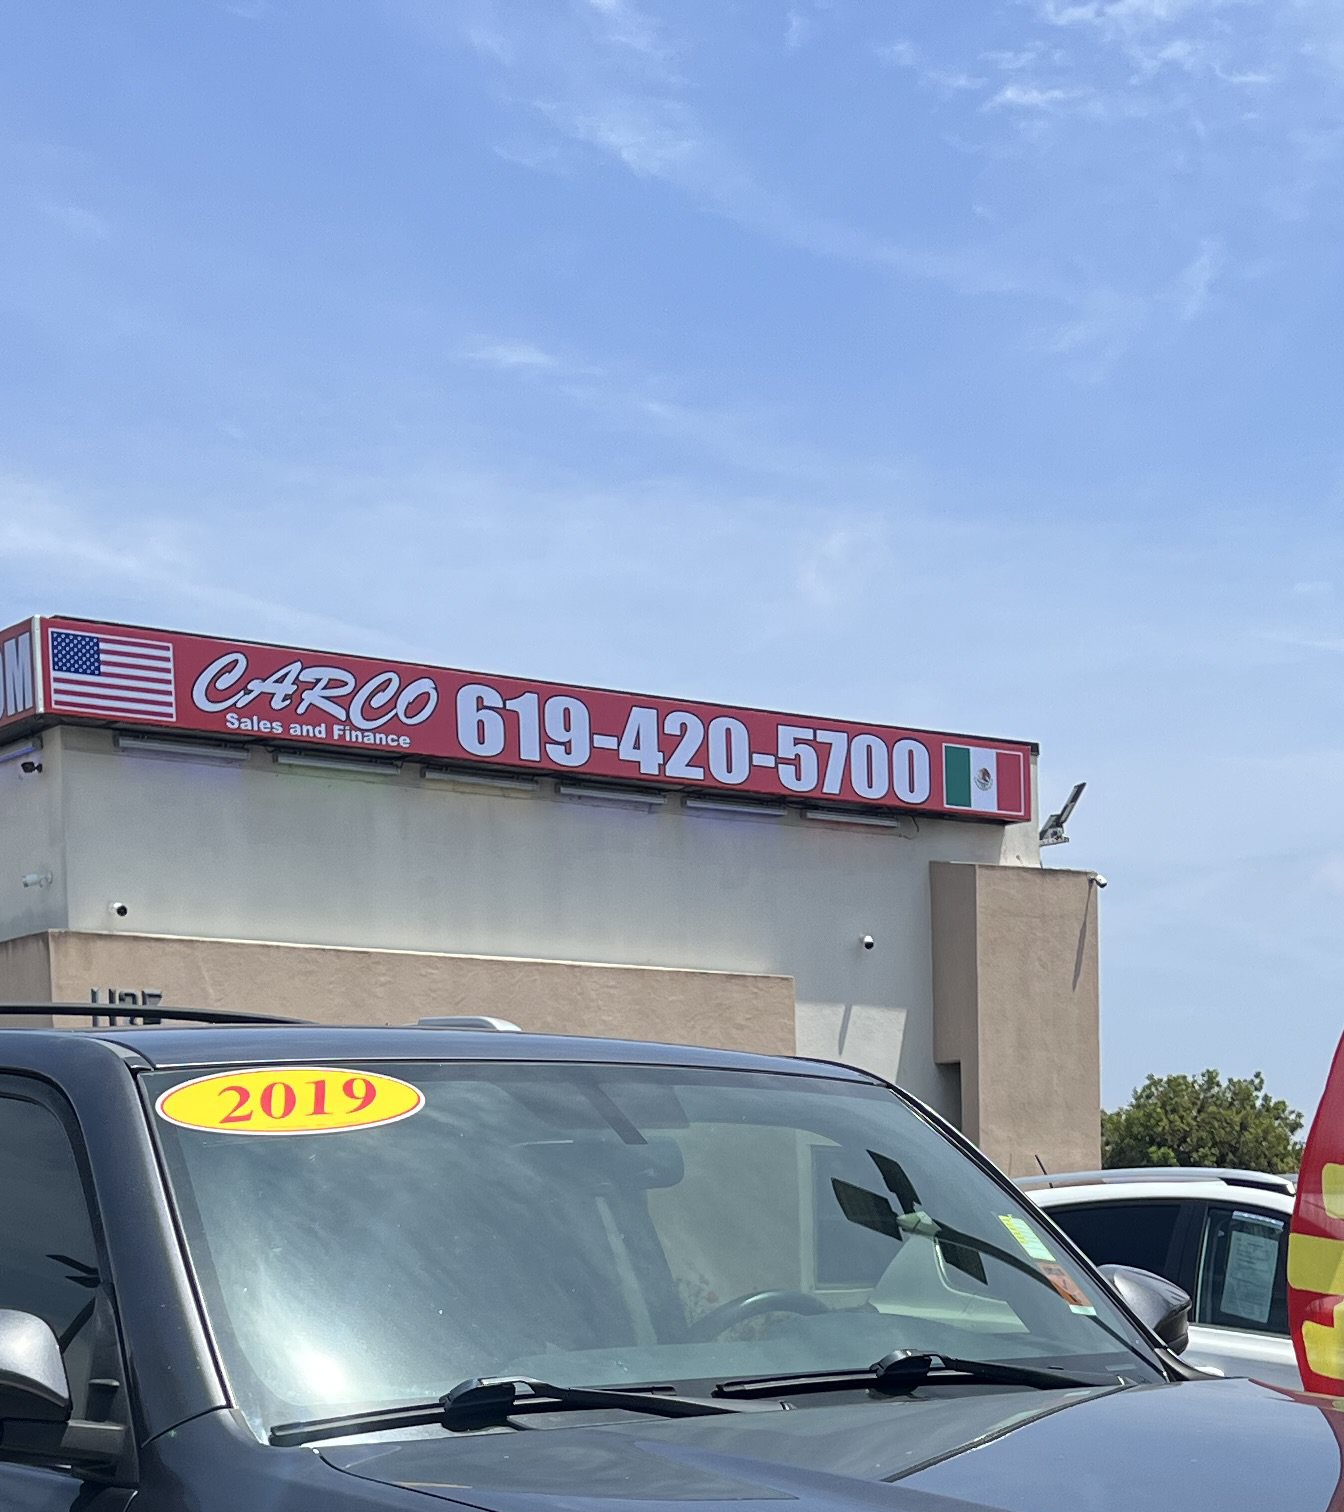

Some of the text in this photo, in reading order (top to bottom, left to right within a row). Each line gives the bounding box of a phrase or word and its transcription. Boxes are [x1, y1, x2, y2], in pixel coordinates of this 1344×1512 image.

[191, 651, 439, 731] CARCO
[226, 713, 411, 748] Sales and Finance
[455, 683, 932, 804] 619-420-5700
[218, 1077, 377, 1124] 2019
